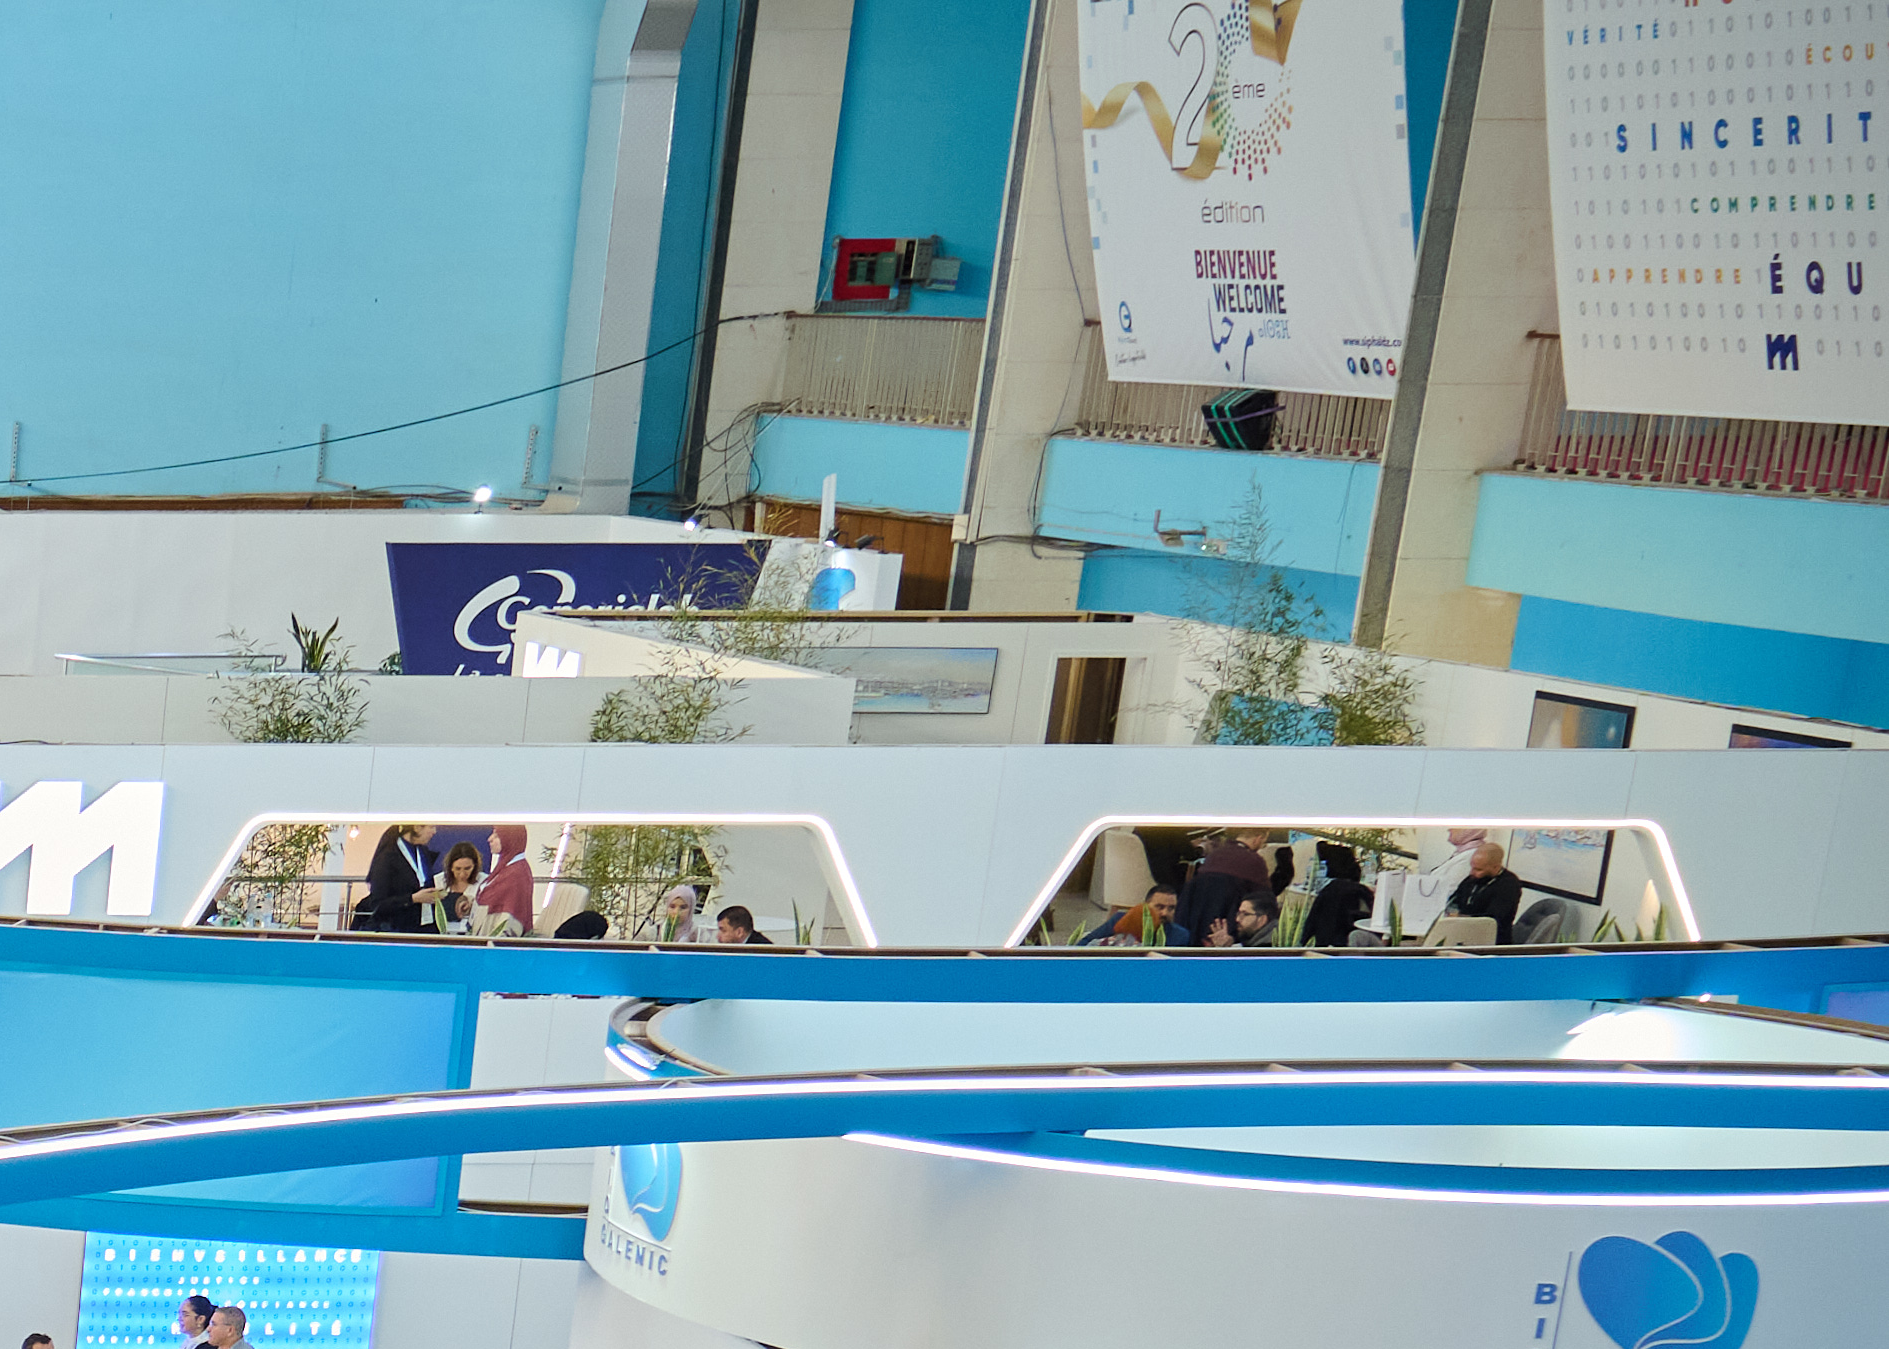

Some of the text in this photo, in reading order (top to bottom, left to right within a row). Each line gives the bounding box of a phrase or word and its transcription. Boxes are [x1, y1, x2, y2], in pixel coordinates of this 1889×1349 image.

[1567, 19, 1660, 46] VÉRITÉ
[1805, 42, 1889, 66] ÉCOU
[1231, 78, 1265, 101] ème
[1616, 111, 1872, 153] SINCERIT
[1201, 198, 1265, 224] édition
[1690, 193, 1876, 214] COMPRENDRE
[1194, 250, 1277, 280] BIENVENUE
[1592, 253, 1863, 295] APPRENDRE ÉQU
[1213, 283, 1287, 314] WELCOME
[104, 1248, 362, 1263] BIENVEILLANCE
[600, 1223, 670, 1278] GALENIC
